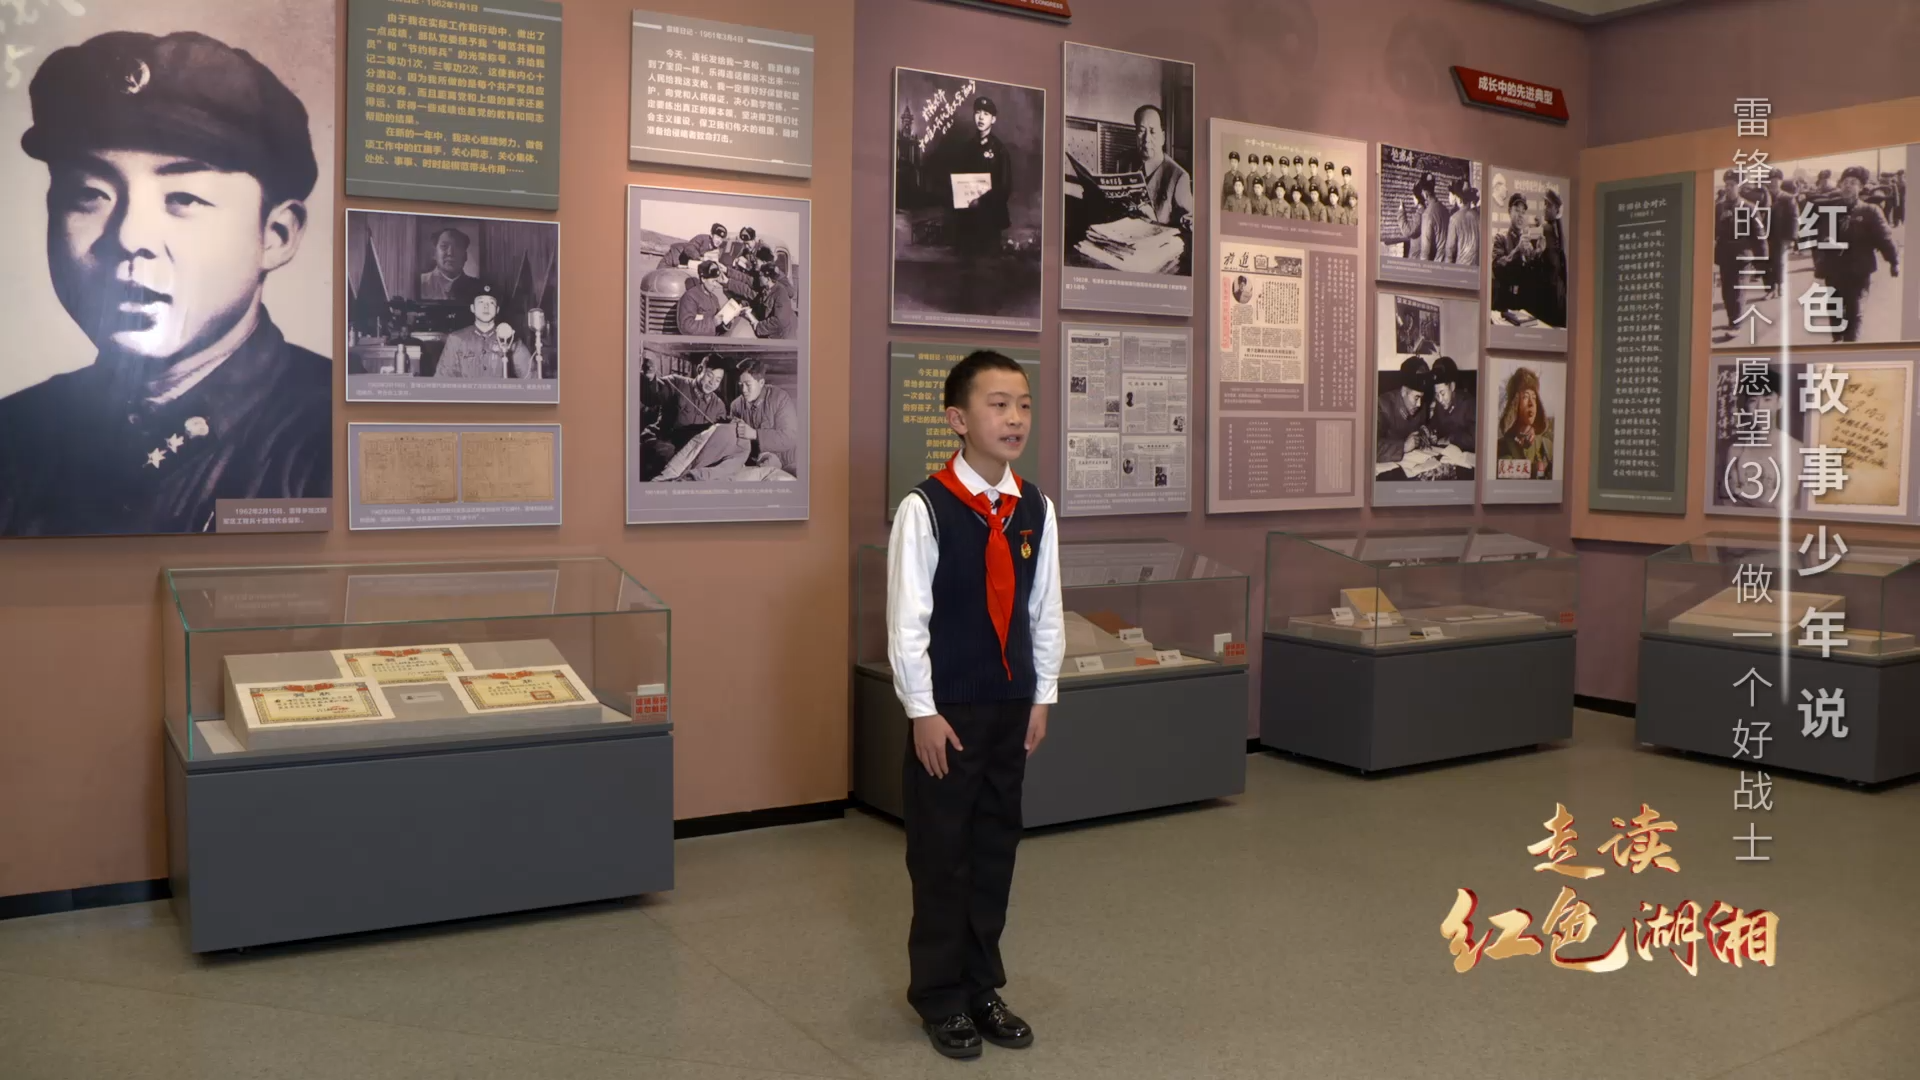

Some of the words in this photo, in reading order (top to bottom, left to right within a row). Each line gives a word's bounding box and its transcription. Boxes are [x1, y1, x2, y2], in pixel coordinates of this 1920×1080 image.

[1478, 76, 1553, 105] 成长中的先进典型
